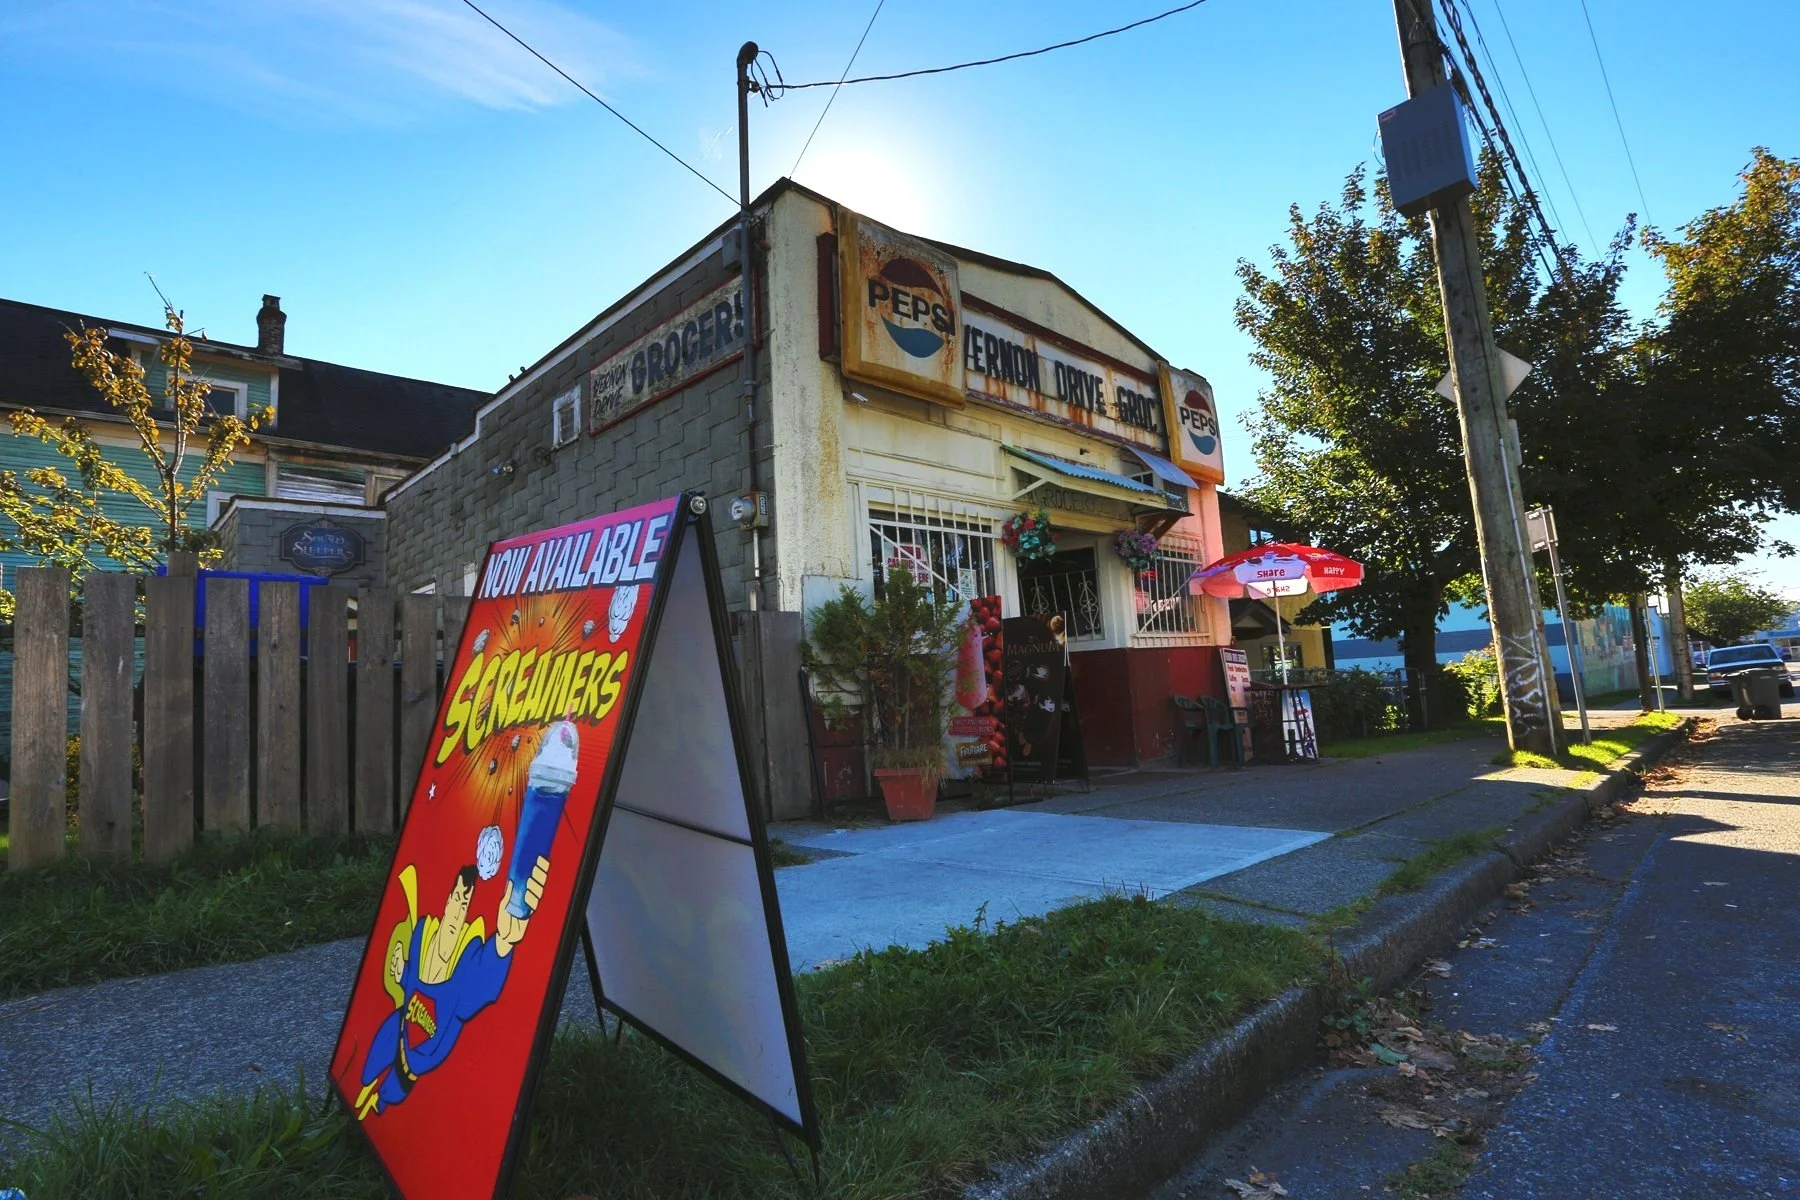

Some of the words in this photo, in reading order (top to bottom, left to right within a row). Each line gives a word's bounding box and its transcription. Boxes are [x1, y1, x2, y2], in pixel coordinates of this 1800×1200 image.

[868, 278, 956, 336] PEPSI
[1055, 360, 1107, 416] DRIVE
[478, 544, 532, 599] NOW
[522, 514, 669, 594] AVAILABLE
[436, 646, 629, 764] SCREAMERS
